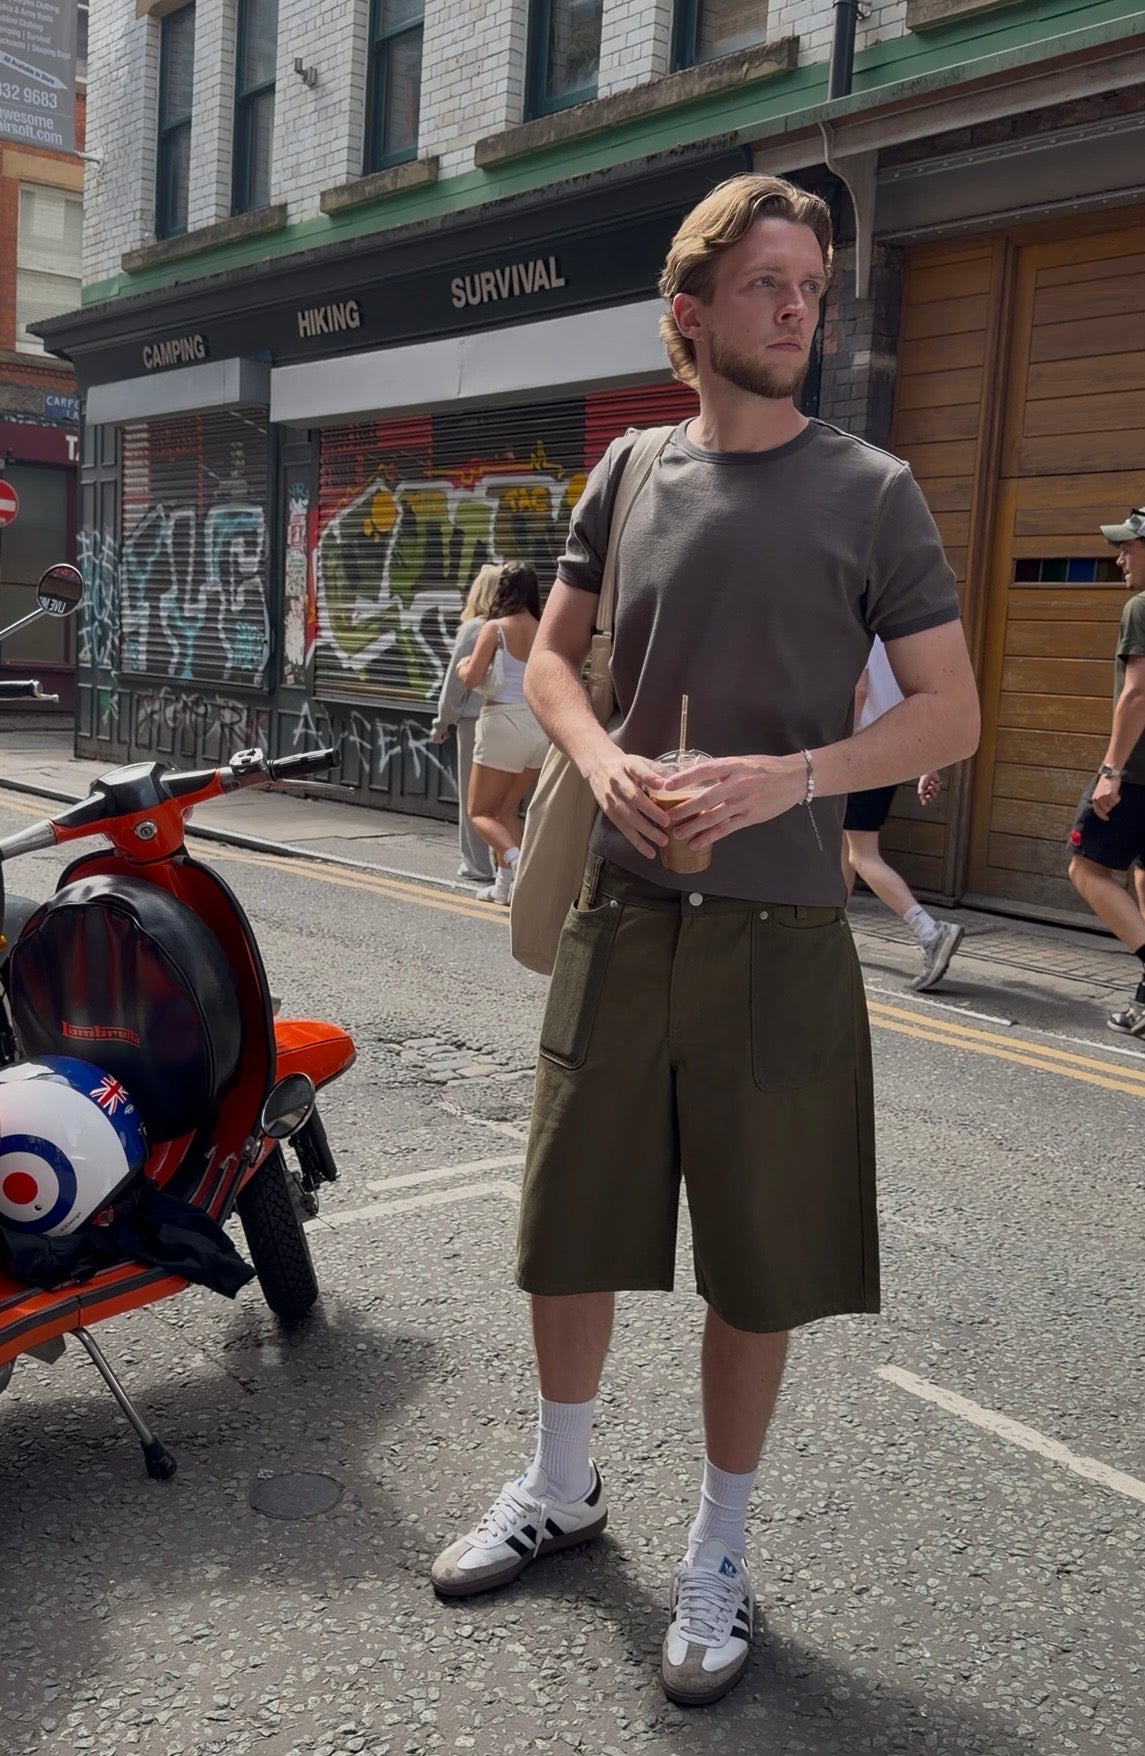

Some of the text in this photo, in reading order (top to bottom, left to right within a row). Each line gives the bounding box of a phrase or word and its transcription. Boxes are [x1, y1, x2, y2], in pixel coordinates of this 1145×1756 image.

[23, 87, 58, 109] 9683
[0, 107, 54, 130] wesome
[451, 256, 566, 308] SURVIVAL
[297, 300, 360, 338] HIKING
[143, 334, 206, 369] CAMPING
[65, 434, 80, 462] T
